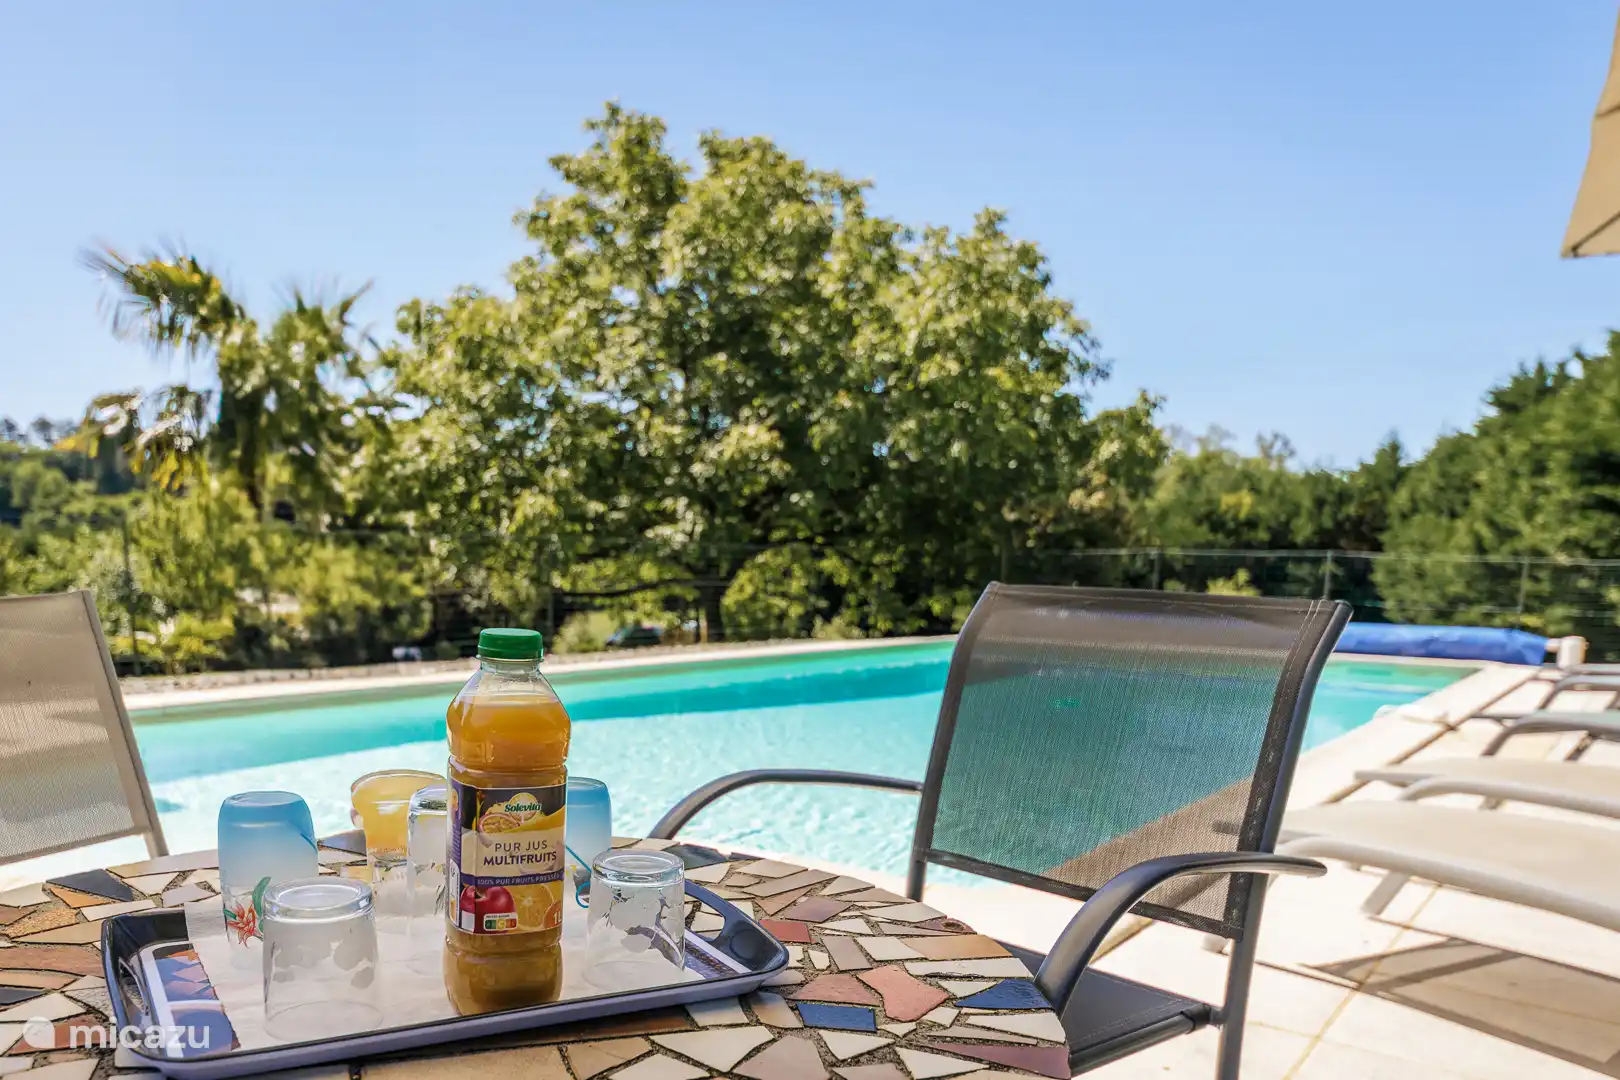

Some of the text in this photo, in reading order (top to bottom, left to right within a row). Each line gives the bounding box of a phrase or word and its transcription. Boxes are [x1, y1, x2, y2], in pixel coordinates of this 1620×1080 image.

[504, 803, 542, 813] Solevita
[494, 840, 548, 852] PUR JUS
[483, 851, 557, 866] MULTIFRUITS
